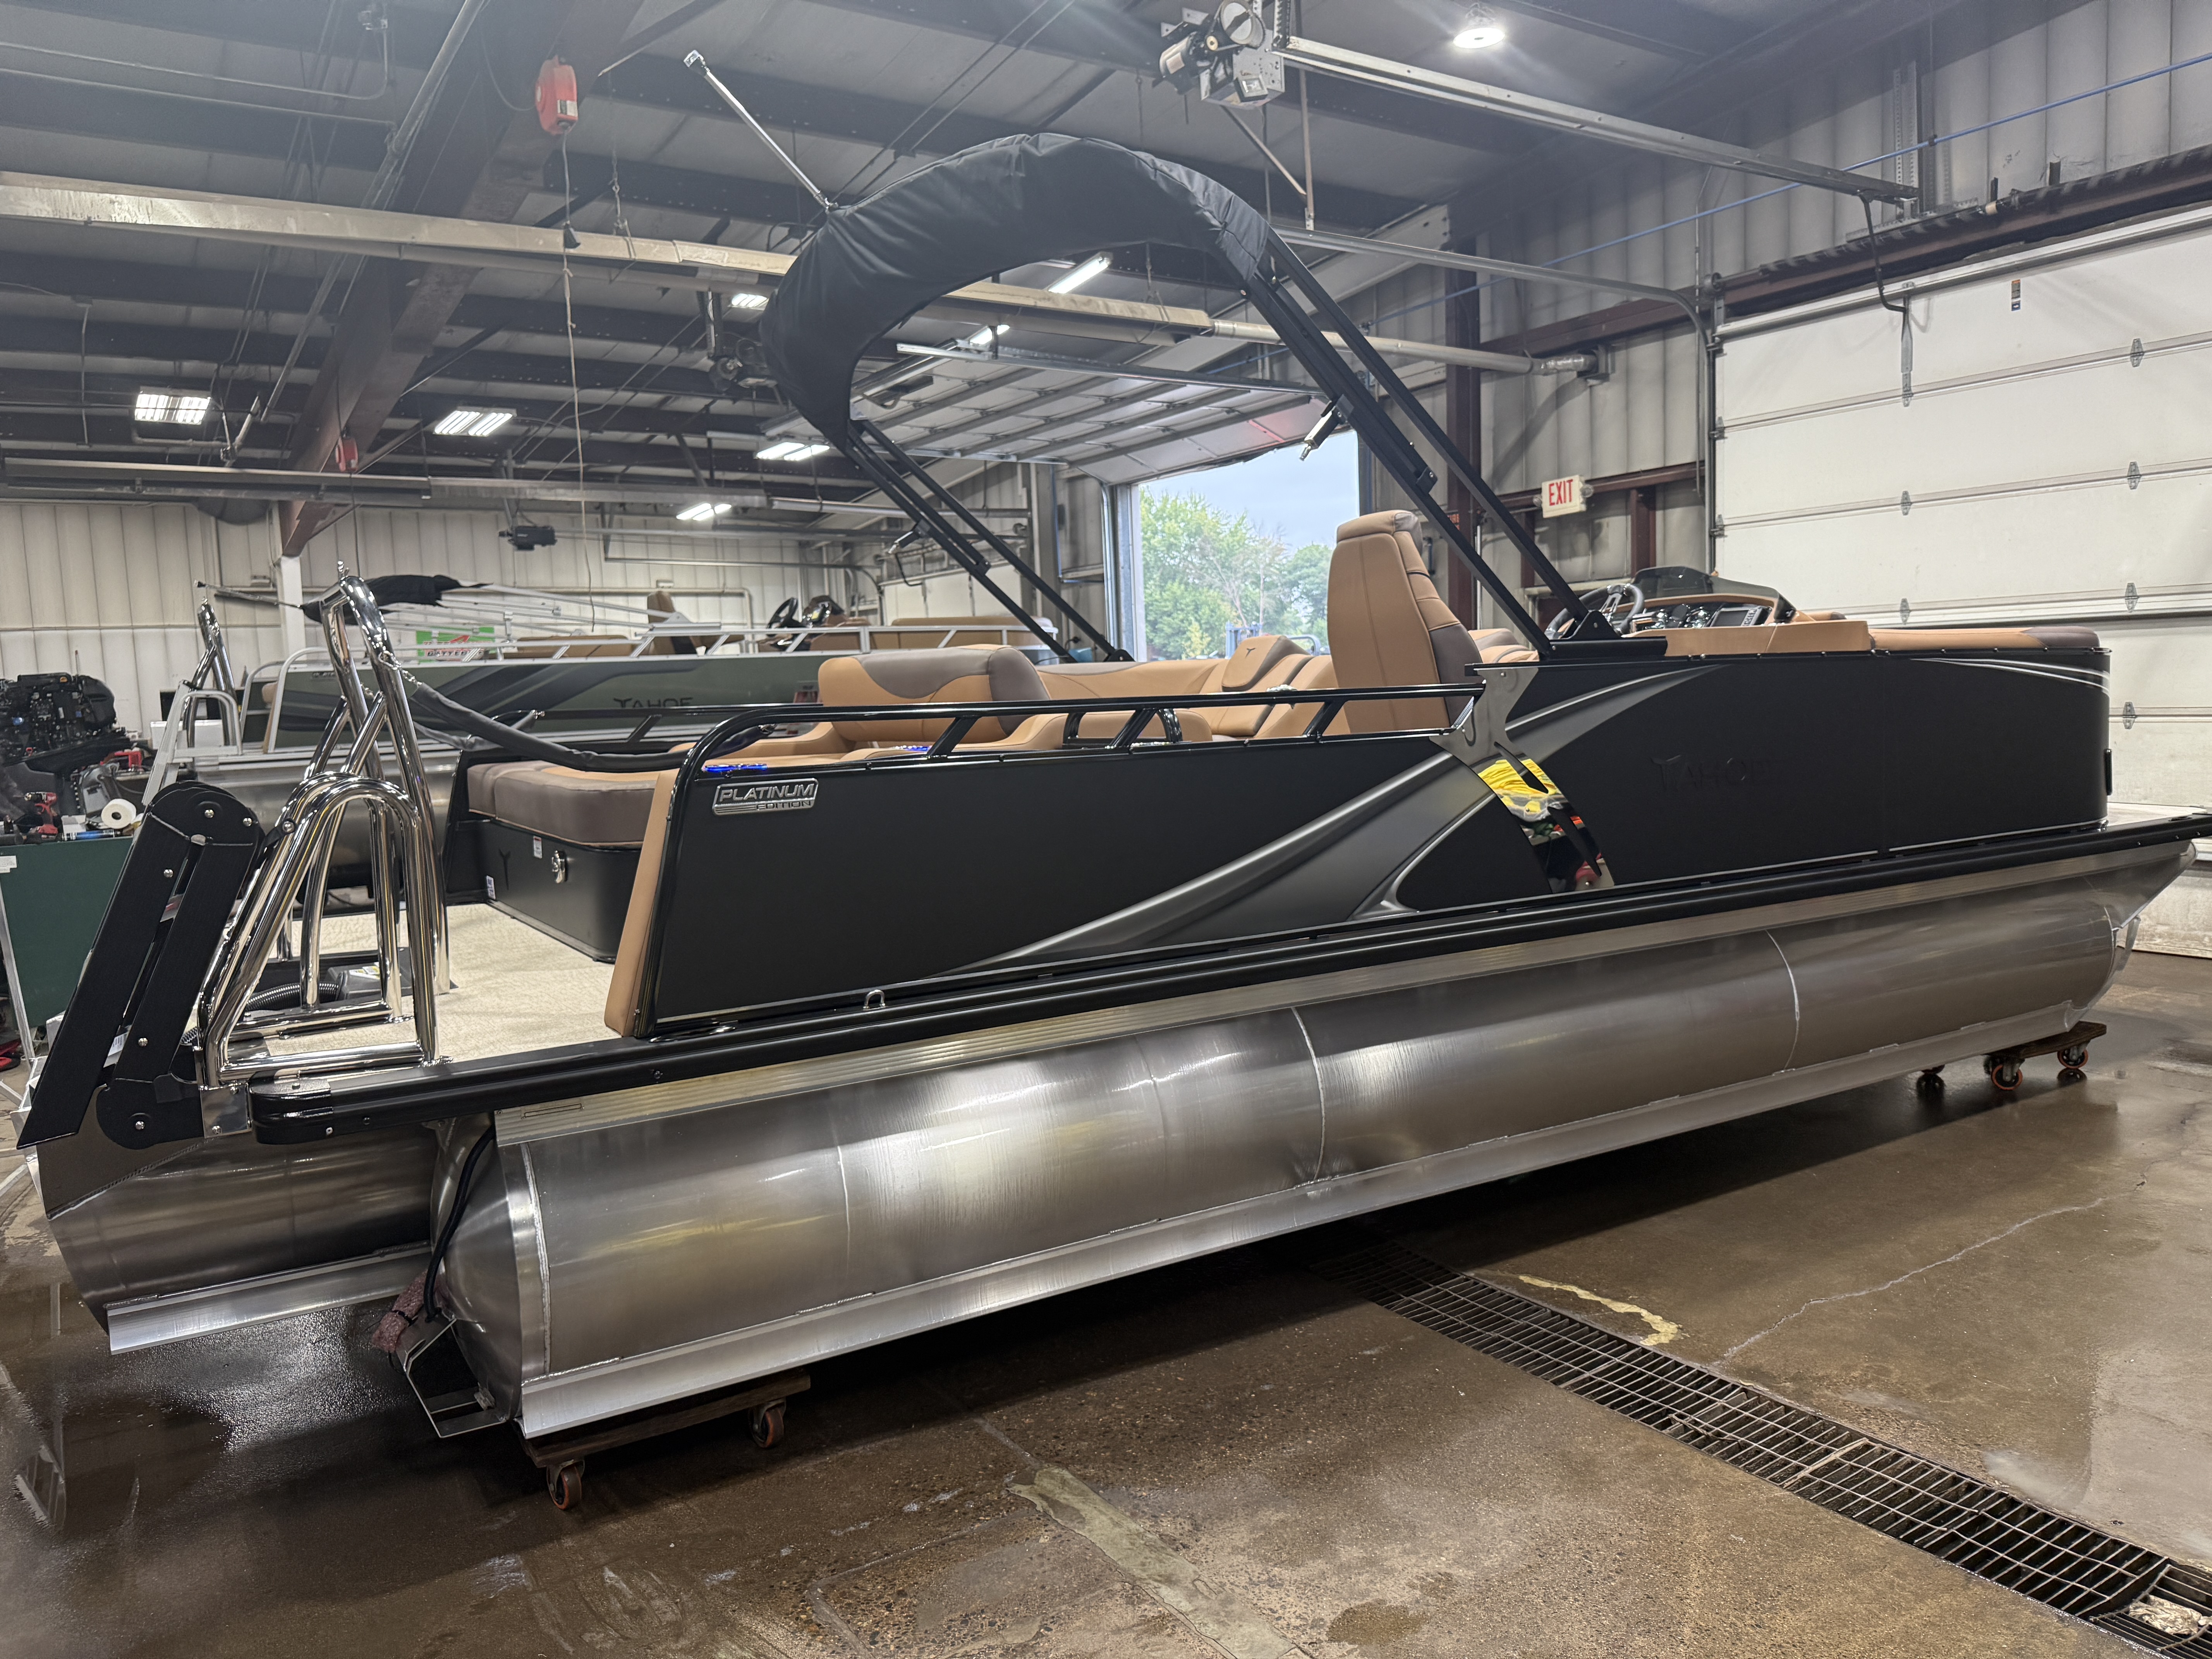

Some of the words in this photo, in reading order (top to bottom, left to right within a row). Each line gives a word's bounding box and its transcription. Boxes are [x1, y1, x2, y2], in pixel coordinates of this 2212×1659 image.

[1549, 479, 1573, 506] EXIT
[614, 697, 693, 708] TAHOE
[1650, 755, 1772, 793] TAHOE
[720, 784, 814, 802] PLATINUM
[756, 800, 811, 810] EDITION
